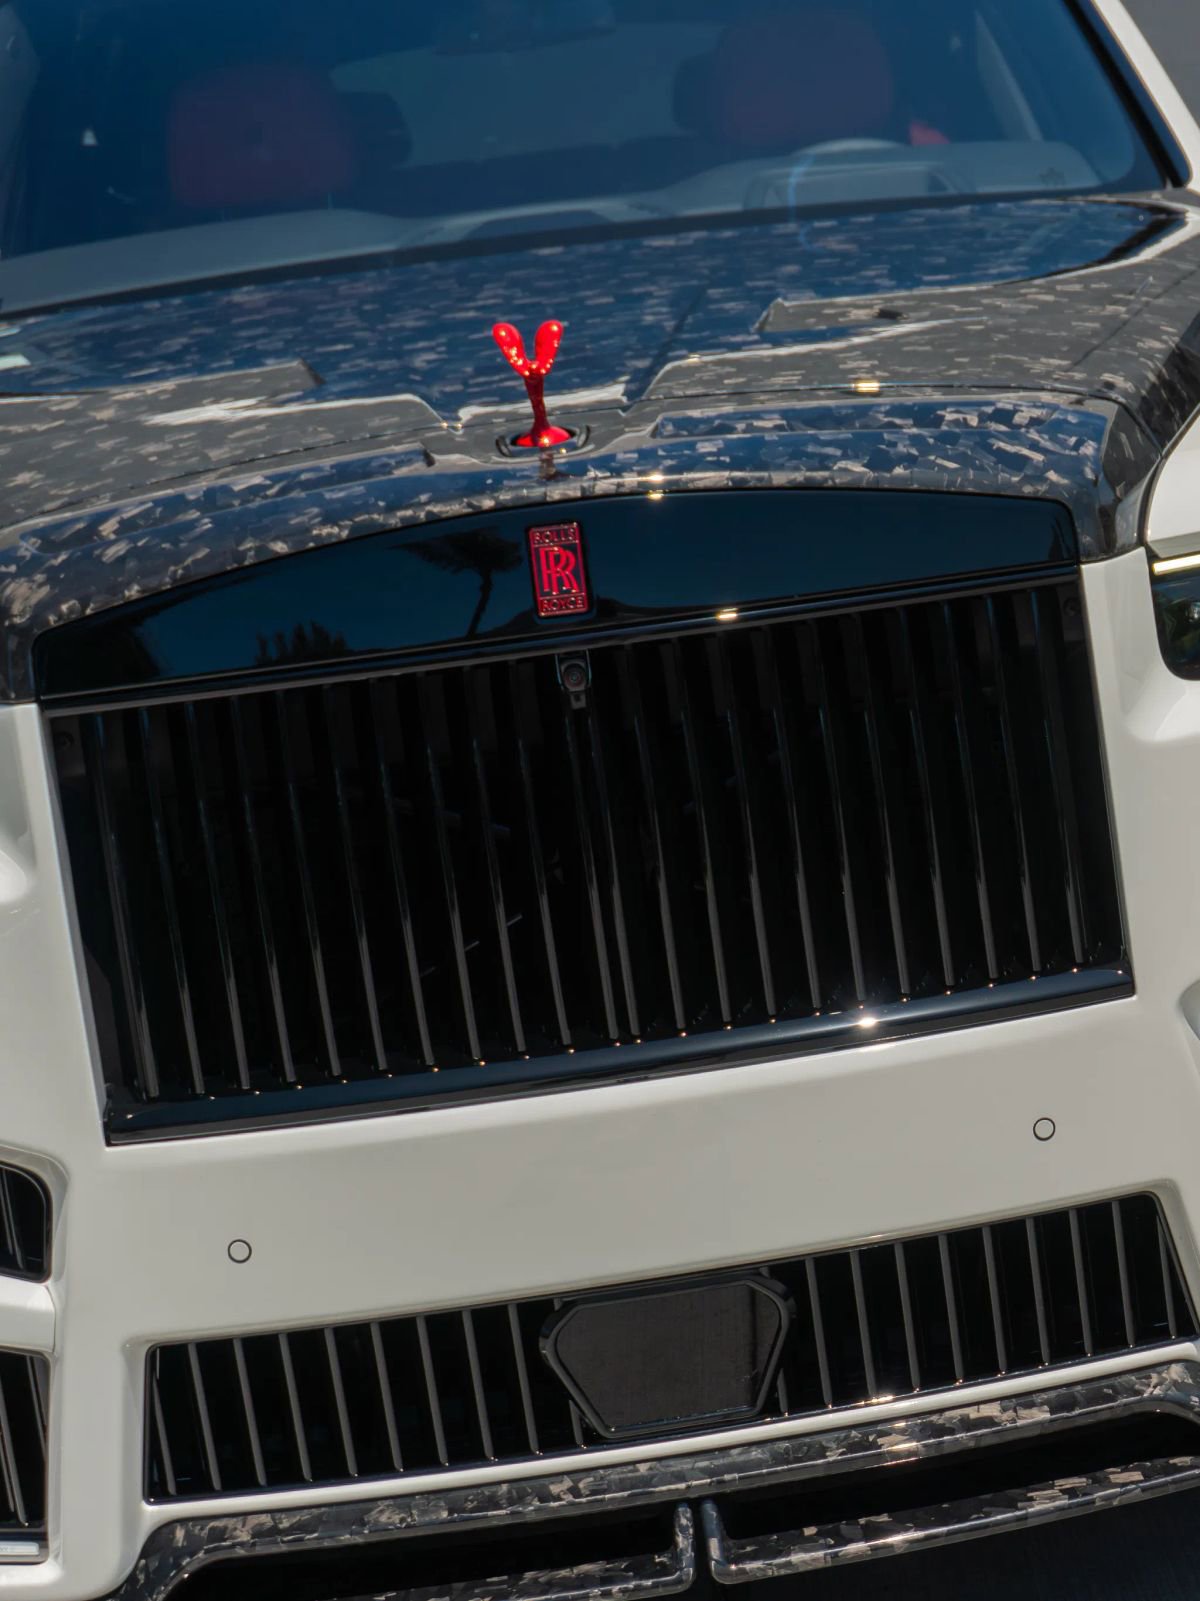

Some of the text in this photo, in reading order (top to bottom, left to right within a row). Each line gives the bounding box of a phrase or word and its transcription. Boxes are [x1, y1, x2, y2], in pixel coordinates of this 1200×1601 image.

[533, 528, 575, 543] ROLLS
[540, 547, 579, 594] RR
[542, 597, 584, 611] ROYCE
